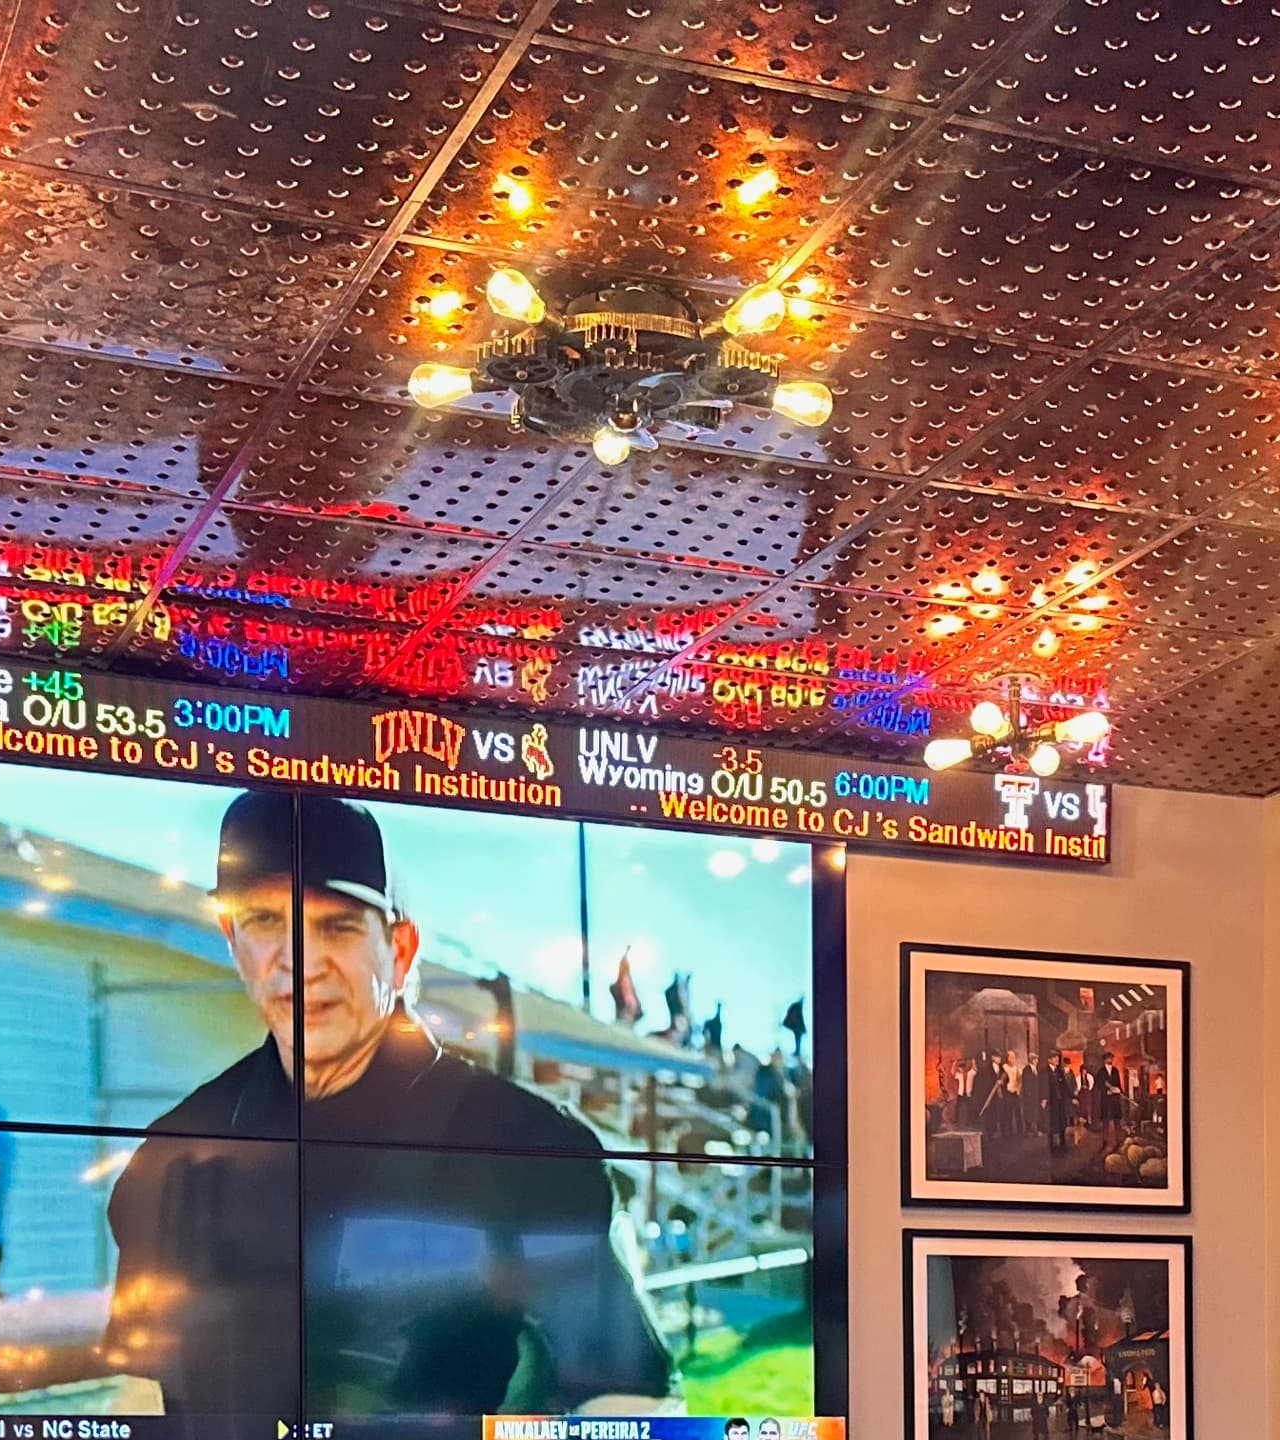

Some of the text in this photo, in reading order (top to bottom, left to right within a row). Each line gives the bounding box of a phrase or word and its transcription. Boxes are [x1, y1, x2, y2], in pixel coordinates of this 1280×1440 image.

[22, 671, 84, 701] +45
[23, 695, 86, 730] O/U
[95, 704, 166, 738] 53.5
[174, 696, 290, 738] 3:00PM
[370, 709, 465, 770] UNLV
[579, 728, 763, 774] UNLV -3.5
[109, 736, 142, 765] to
[247, 748, 400, 792] Sandwich
[415, 764, 561, 807] Institution
[578, 755, 828, 807] Wyoming O/U 50.5
[834, 770, 929, 805] 6:00PM
[658, 791, 788, 830] Welcome
[798, 806, 823, 833] to
[909, 815, 1034, 853] Sandwich
[13, 1423, 35, 1439] vs
[42, 1420, 73, 1439] NC
[78, 1420, 132, 1439] State
[312, 1423, 334, 1439] ET
[494, 1421, 568, 1440] ANKALAEV
[580, 1421, 639, 1440] PEREIRA
[641, 1421, 650, 1440] 2
